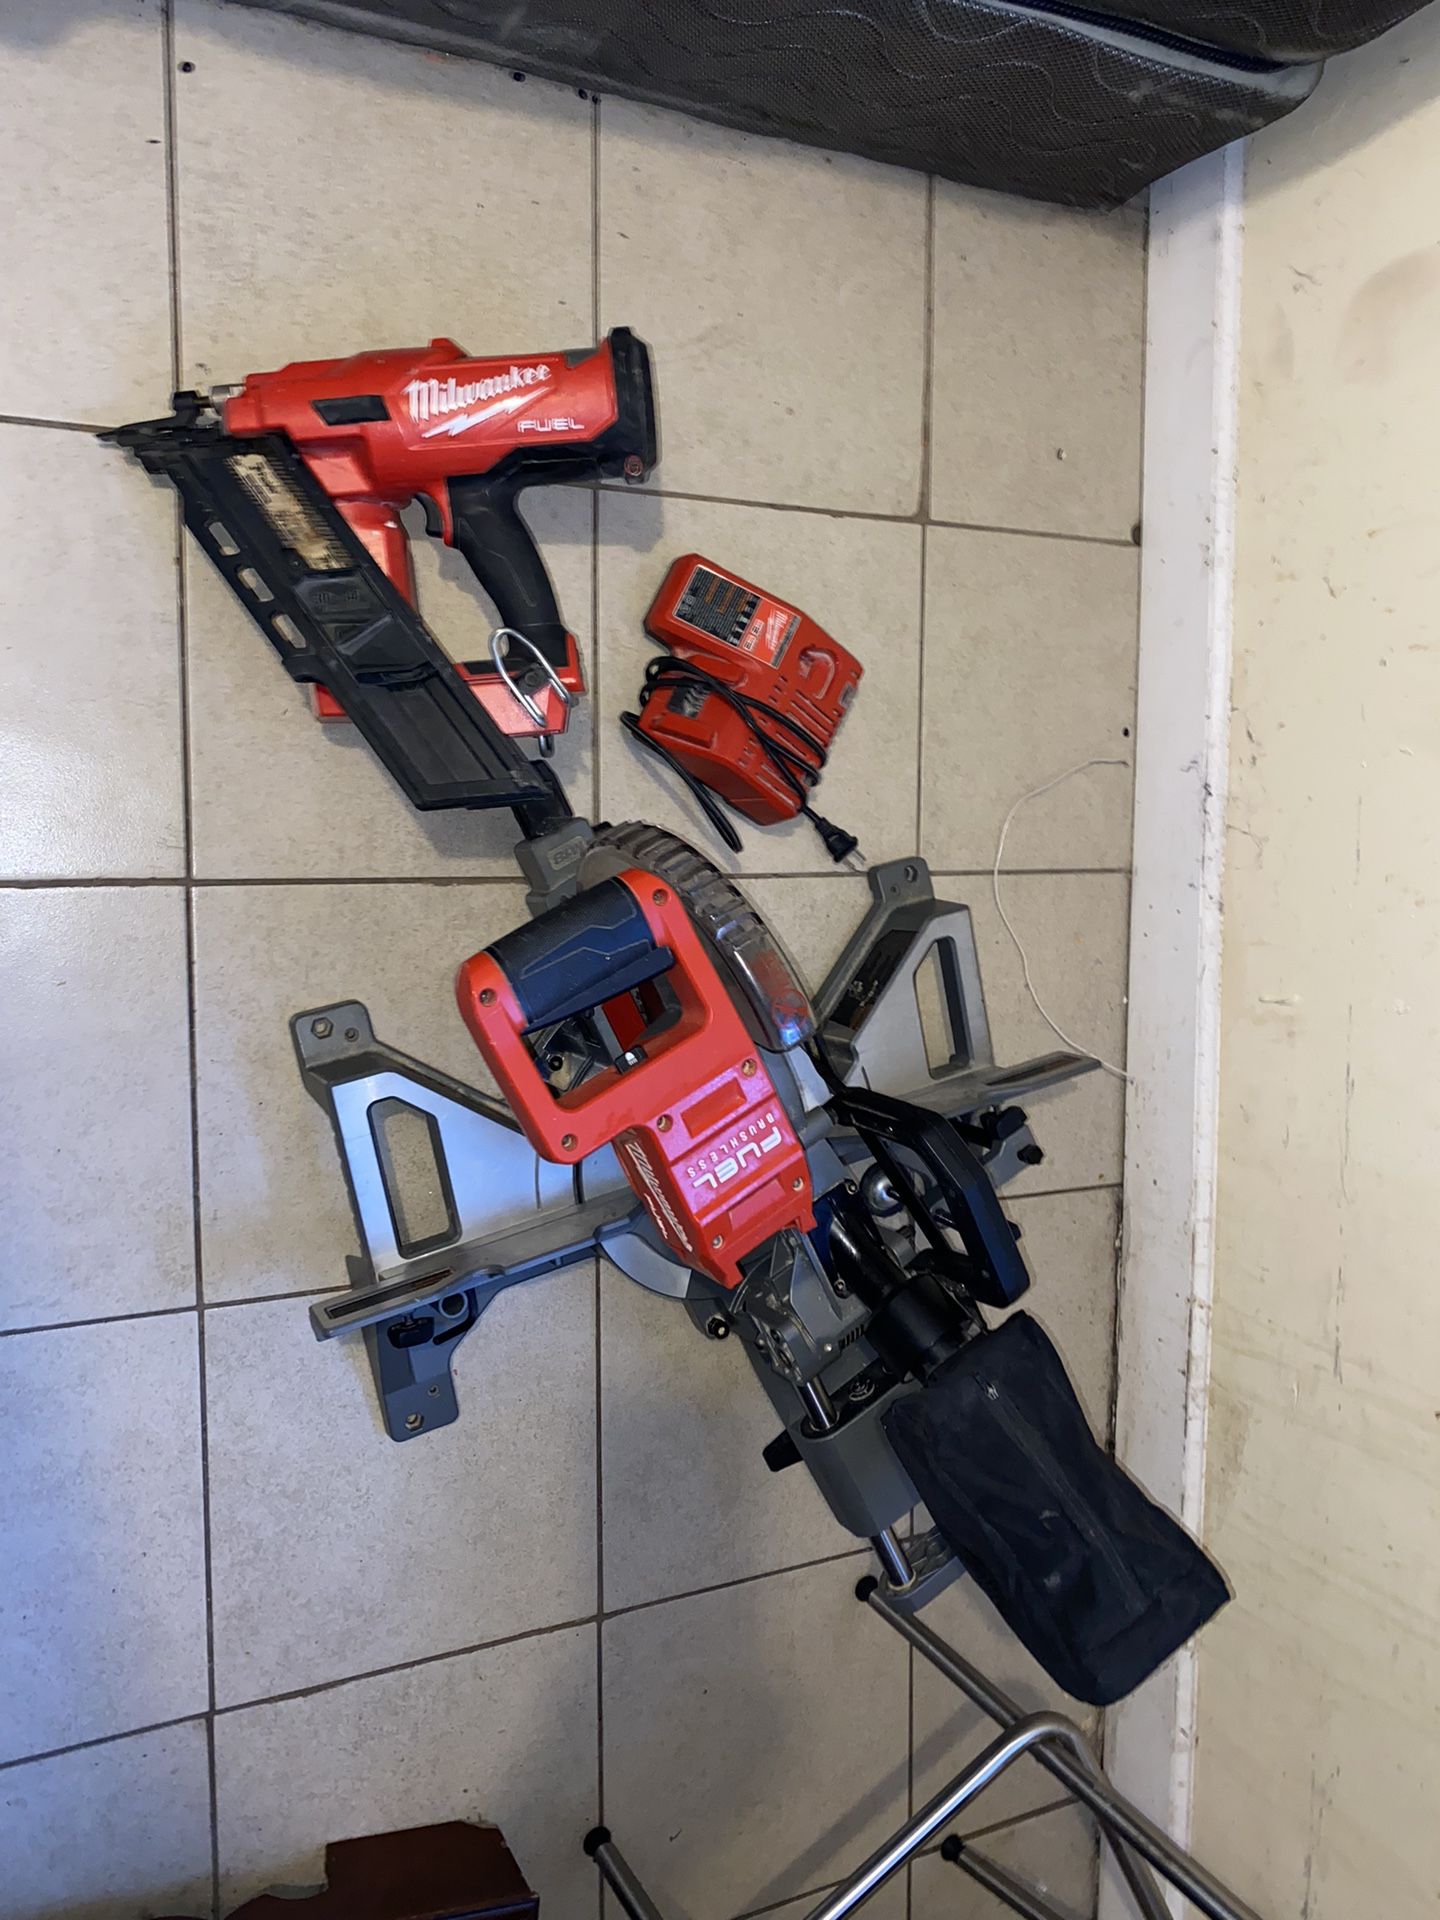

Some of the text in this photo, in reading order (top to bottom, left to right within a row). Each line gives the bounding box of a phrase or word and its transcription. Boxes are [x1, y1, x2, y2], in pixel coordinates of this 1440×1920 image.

[401, 364, 552, 422] Milwaukee
[517, 417, 585, 433] FUEL
[687, 1112, 776, 1178] BRUSHLESS
[693, 1126, 782, 1189] FUEL
